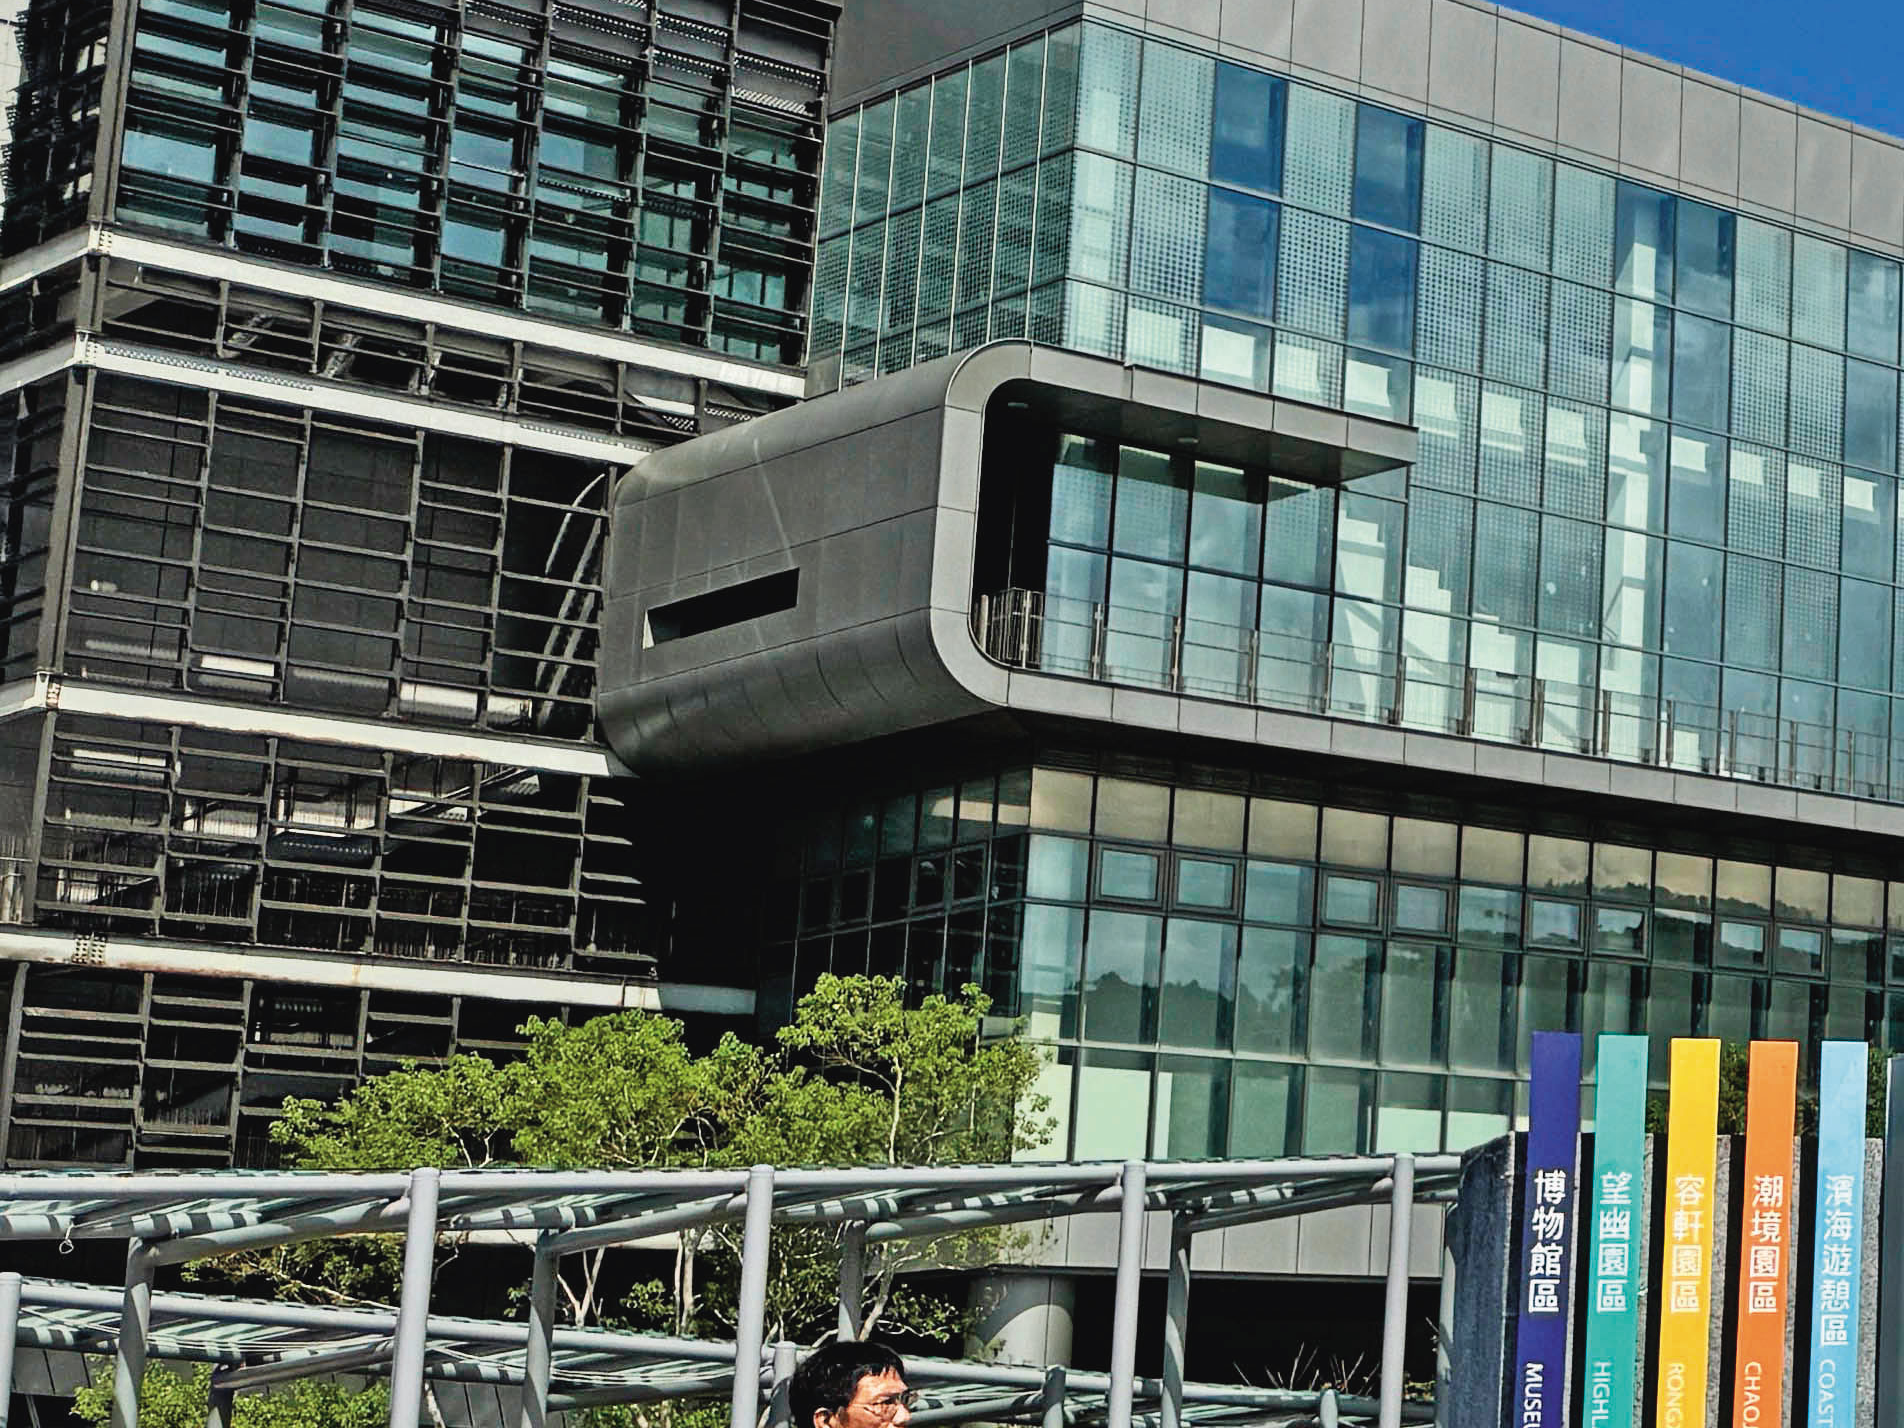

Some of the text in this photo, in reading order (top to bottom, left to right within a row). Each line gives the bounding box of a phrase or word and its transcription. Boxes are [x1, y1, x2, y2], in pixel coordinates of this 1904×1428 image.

[1528, 1169, 1566, 1314] 博物館區
[1596, 1171, 1632, 1314] 望幽園區
[1670, 1174, 1705, 1314] 容軒園區
[1748, 1174, 1784, 1314] 潮境園區
[1819, 1174, 1856, 1347] 濱海遊憩區
